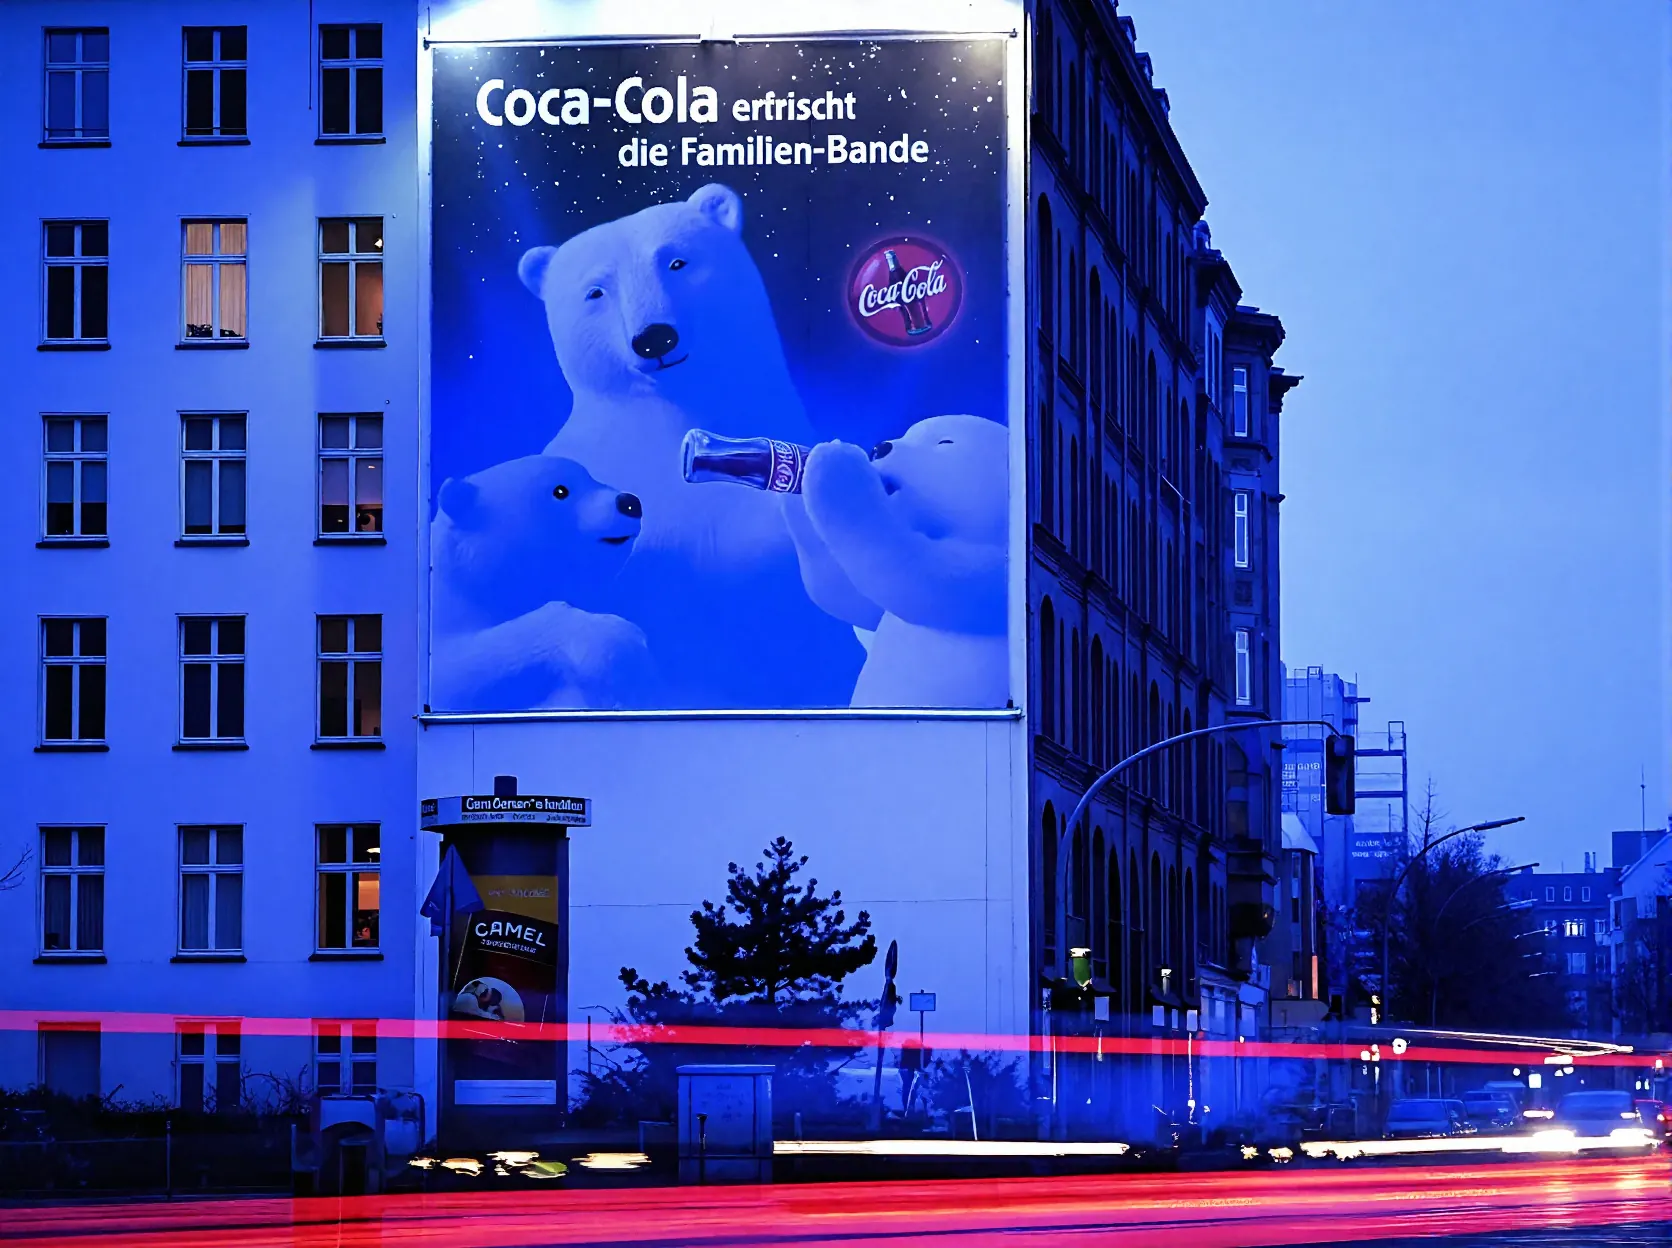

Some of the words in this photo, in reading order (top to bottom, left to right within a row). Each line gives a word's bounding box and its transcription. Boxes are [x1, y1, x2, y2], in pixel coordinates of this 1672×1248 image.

[476, 76, 719, 127] Coca-Cola
[732, 91, 857, 122] erfrischt
[618, 137, 669, 168] die
[681, 133, 930, 167] Familien-Bande
[474, 920, 547, 947] CAMEL
